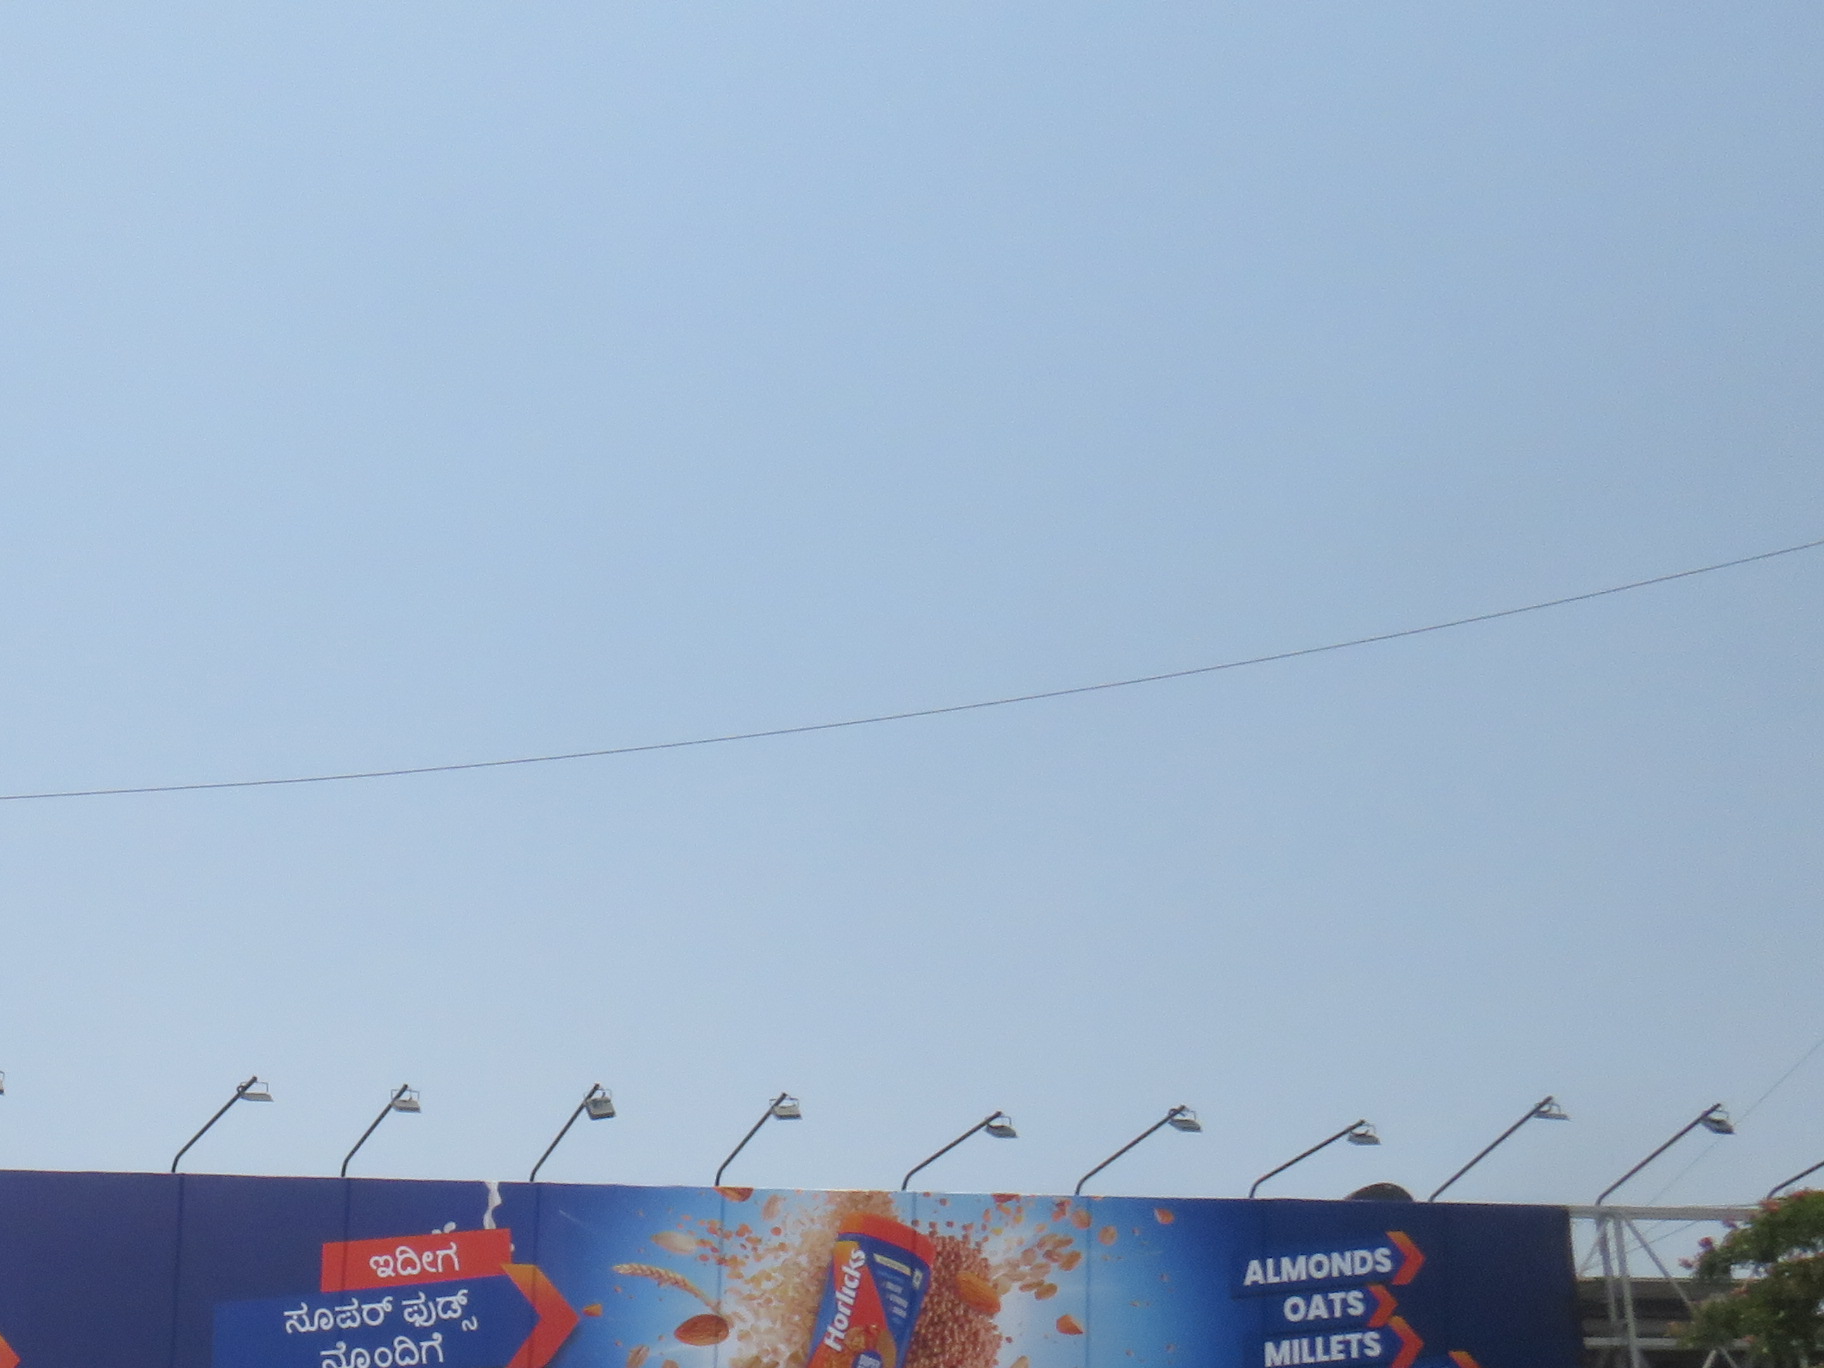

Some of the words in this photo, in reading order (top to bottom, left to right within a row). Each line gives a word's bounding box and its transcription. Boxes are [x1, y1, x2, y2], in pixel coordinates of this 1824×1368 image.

[369, 1242, 460, 1278] ಇದೀಗ
[1243, 1247, 1393, 1286] ALMONDS
[283, 1296, 393, 1334] ಸೂಪರ್
[823, 1247, 866, 1352] Horlicks
[1283, 1289, 1366, 1322] OATS
[1264, 1331, 1382, 1368] MILLETS
